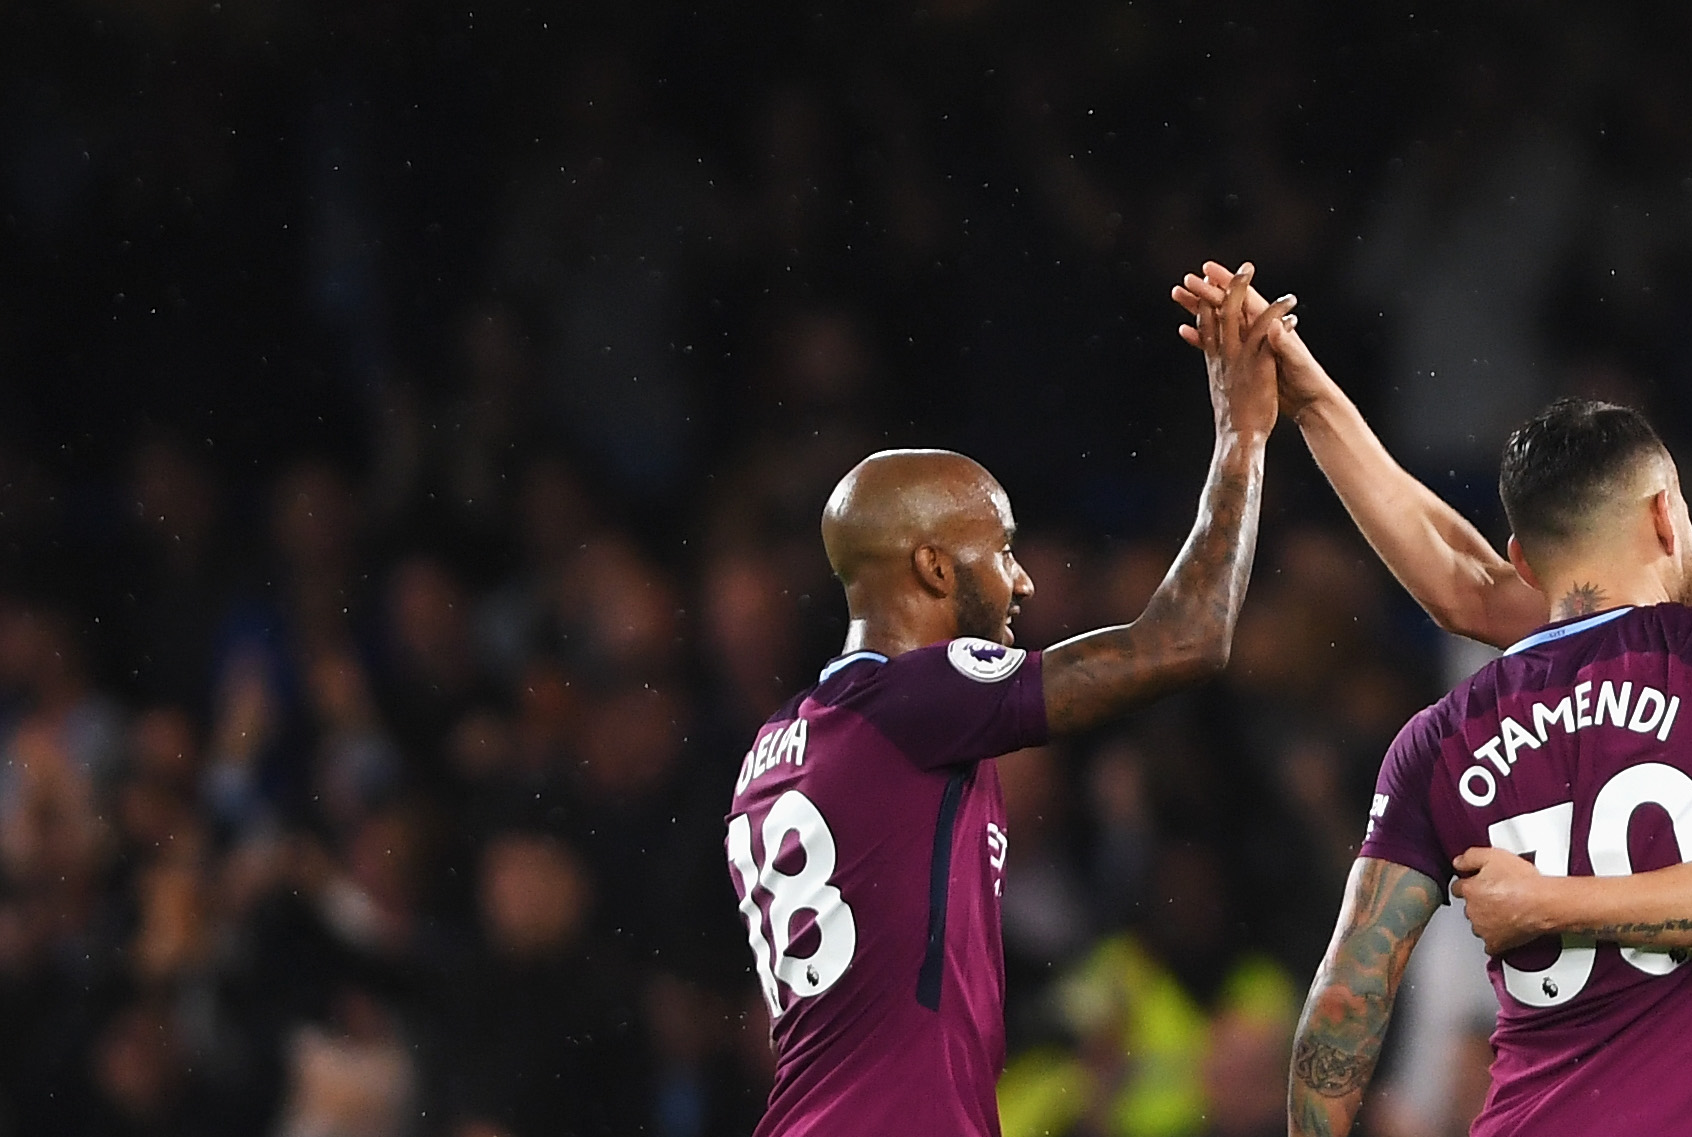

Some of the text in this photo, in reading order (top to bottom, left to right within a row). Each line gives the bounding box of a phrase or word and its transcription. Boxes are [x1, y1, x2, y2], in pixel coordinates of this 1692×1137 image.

[736, 718, 809, 797] DELPH
[1458, 680, 1681, 808] OTAMENDI
[727, 789, 857, 1018] 18
